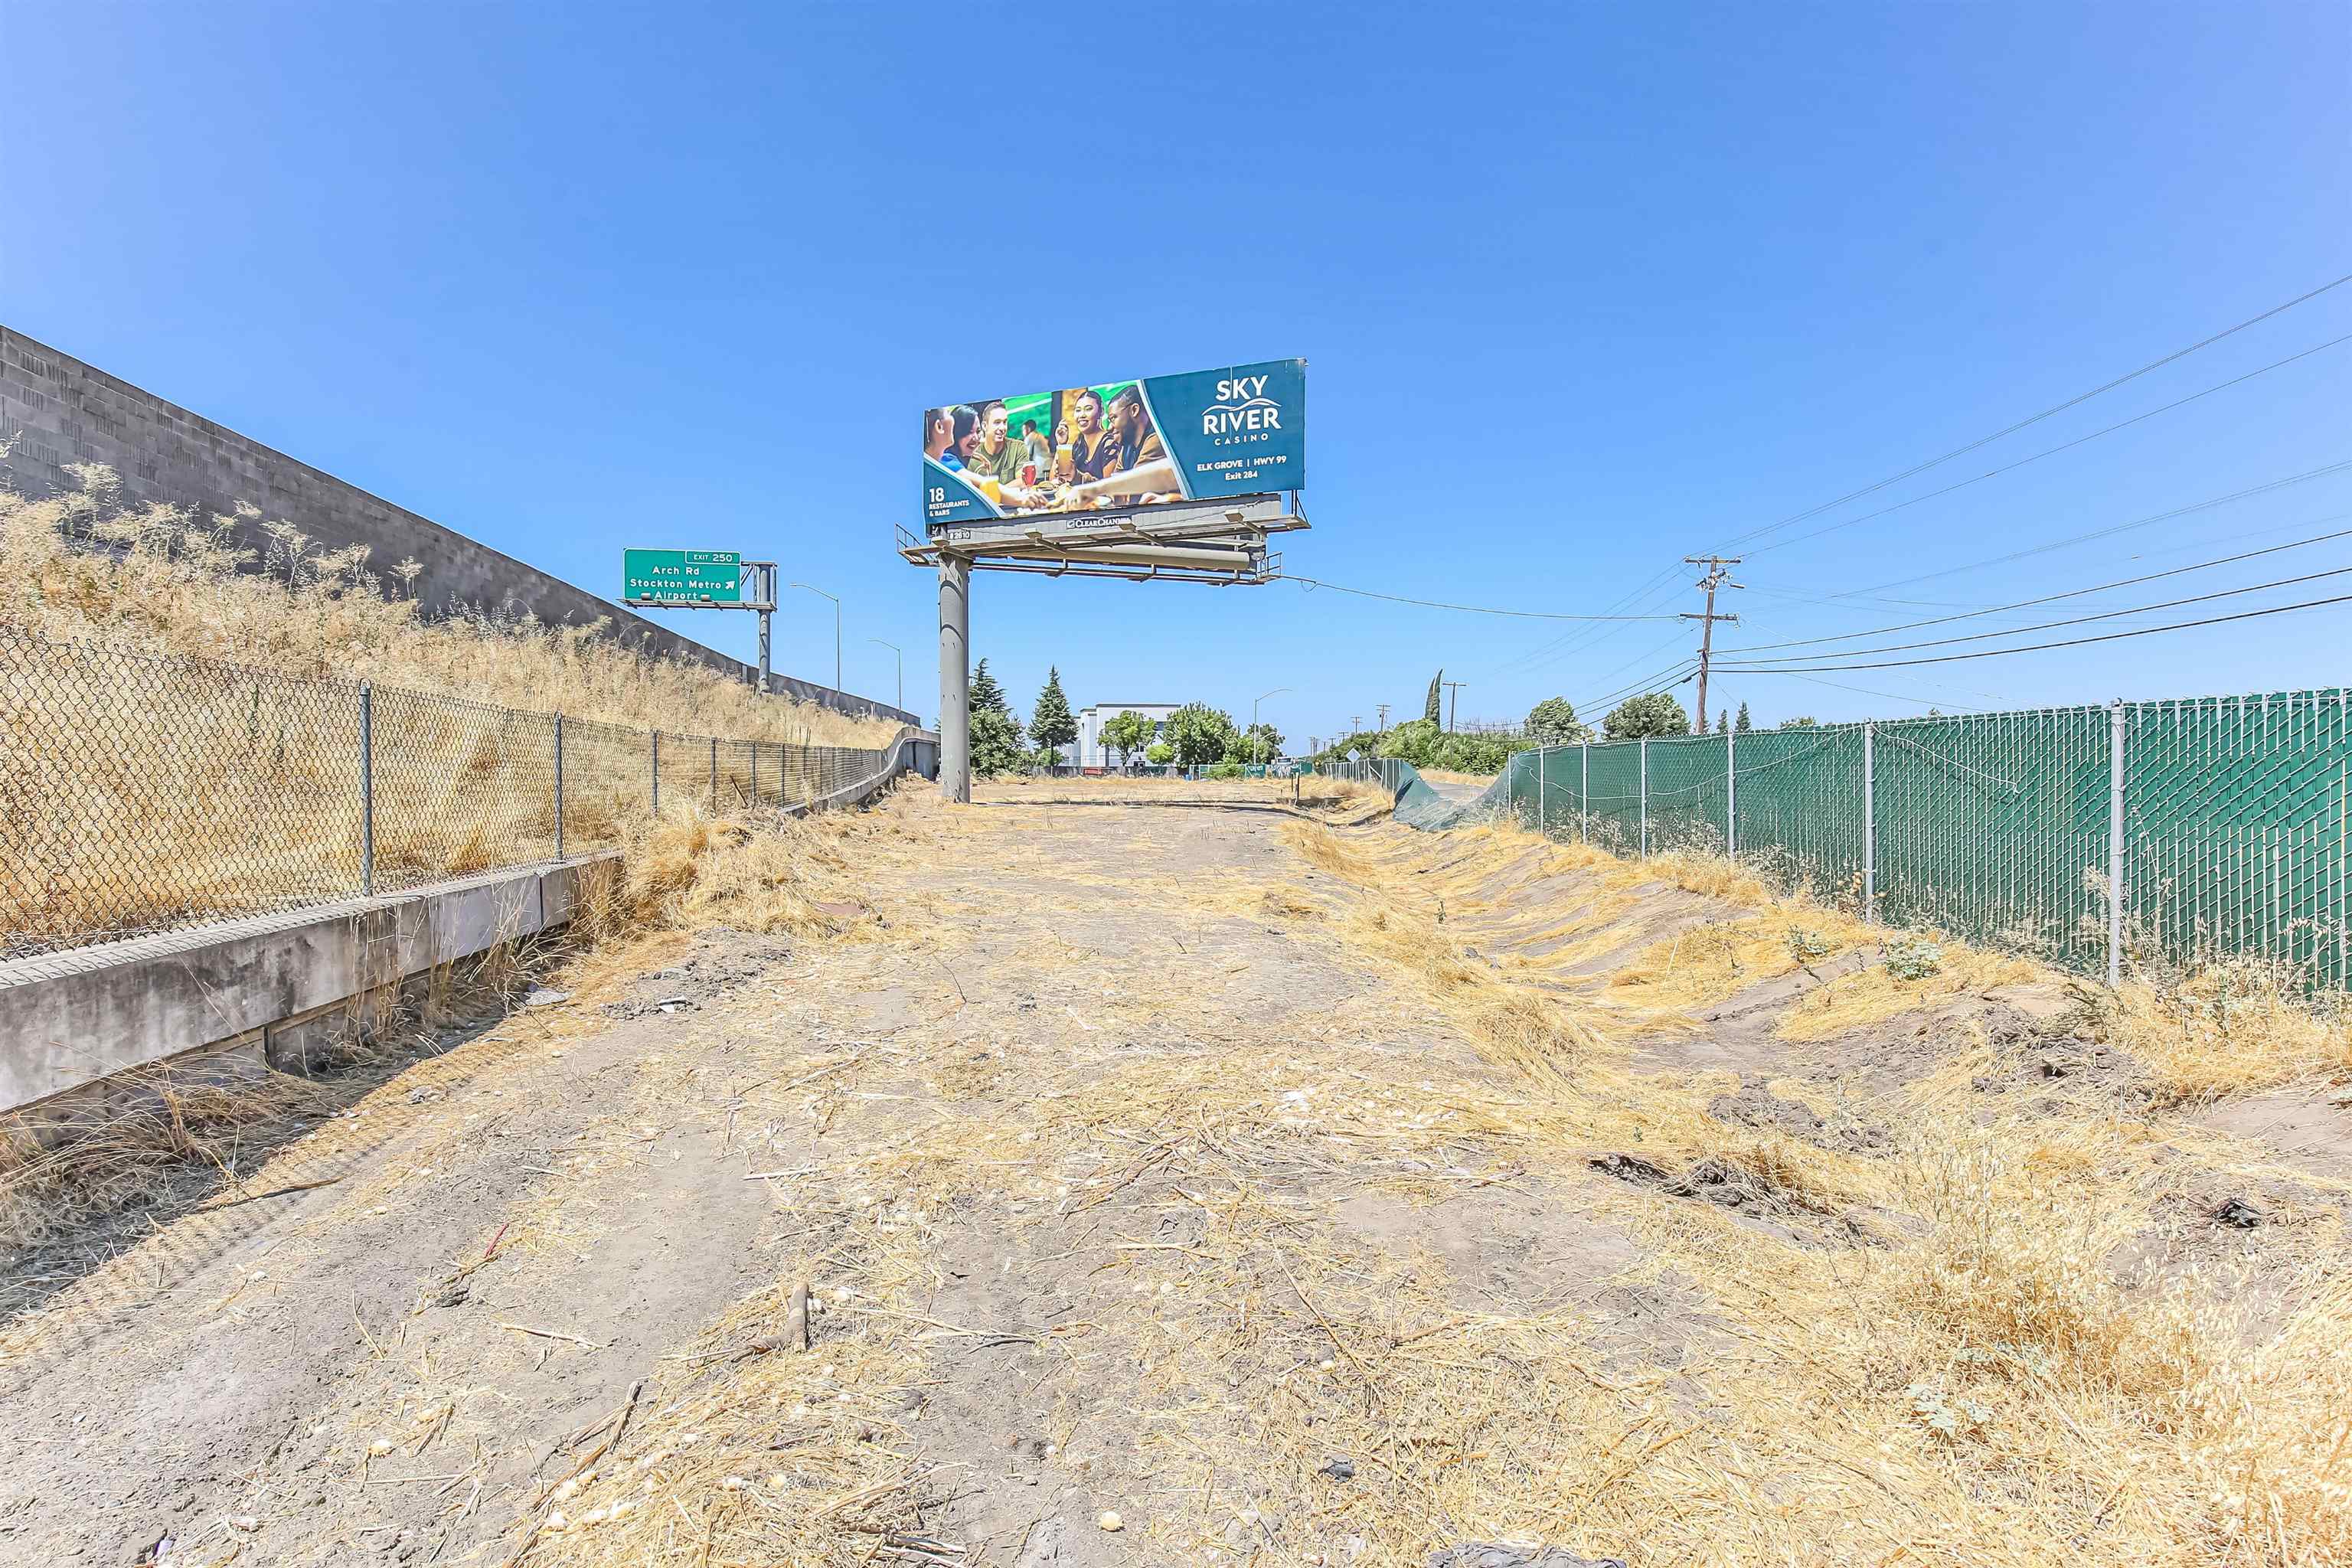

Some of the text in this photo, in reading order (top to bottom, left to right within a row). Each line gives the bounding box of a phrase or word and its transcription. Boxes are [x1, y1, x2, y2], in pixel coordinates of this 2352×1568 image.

[1216, 375, 1269, 401] SKY
[1203, 408, 1282, 435] RIVER
[1214, 433, 1269, 446] CASINO
[1197, 463, 1214, 472] ELK
[1214, 459, 1243, 470] GROVE
[1253, 457, 1275, 466] HWY
[1276, 456, 1287, 464] 99
[1225, 471, 1258, 481] Exit 284
[929, 488, 945, 502] 18
[929, 500, 969, 510] RESTAURANTS
[712, 554, 733, 562] 250
[652, 566, 699, 575] Arch Rd
[630, 578, 721, 589] Stockton Metro
[655, 590, 697, 600] Airport
